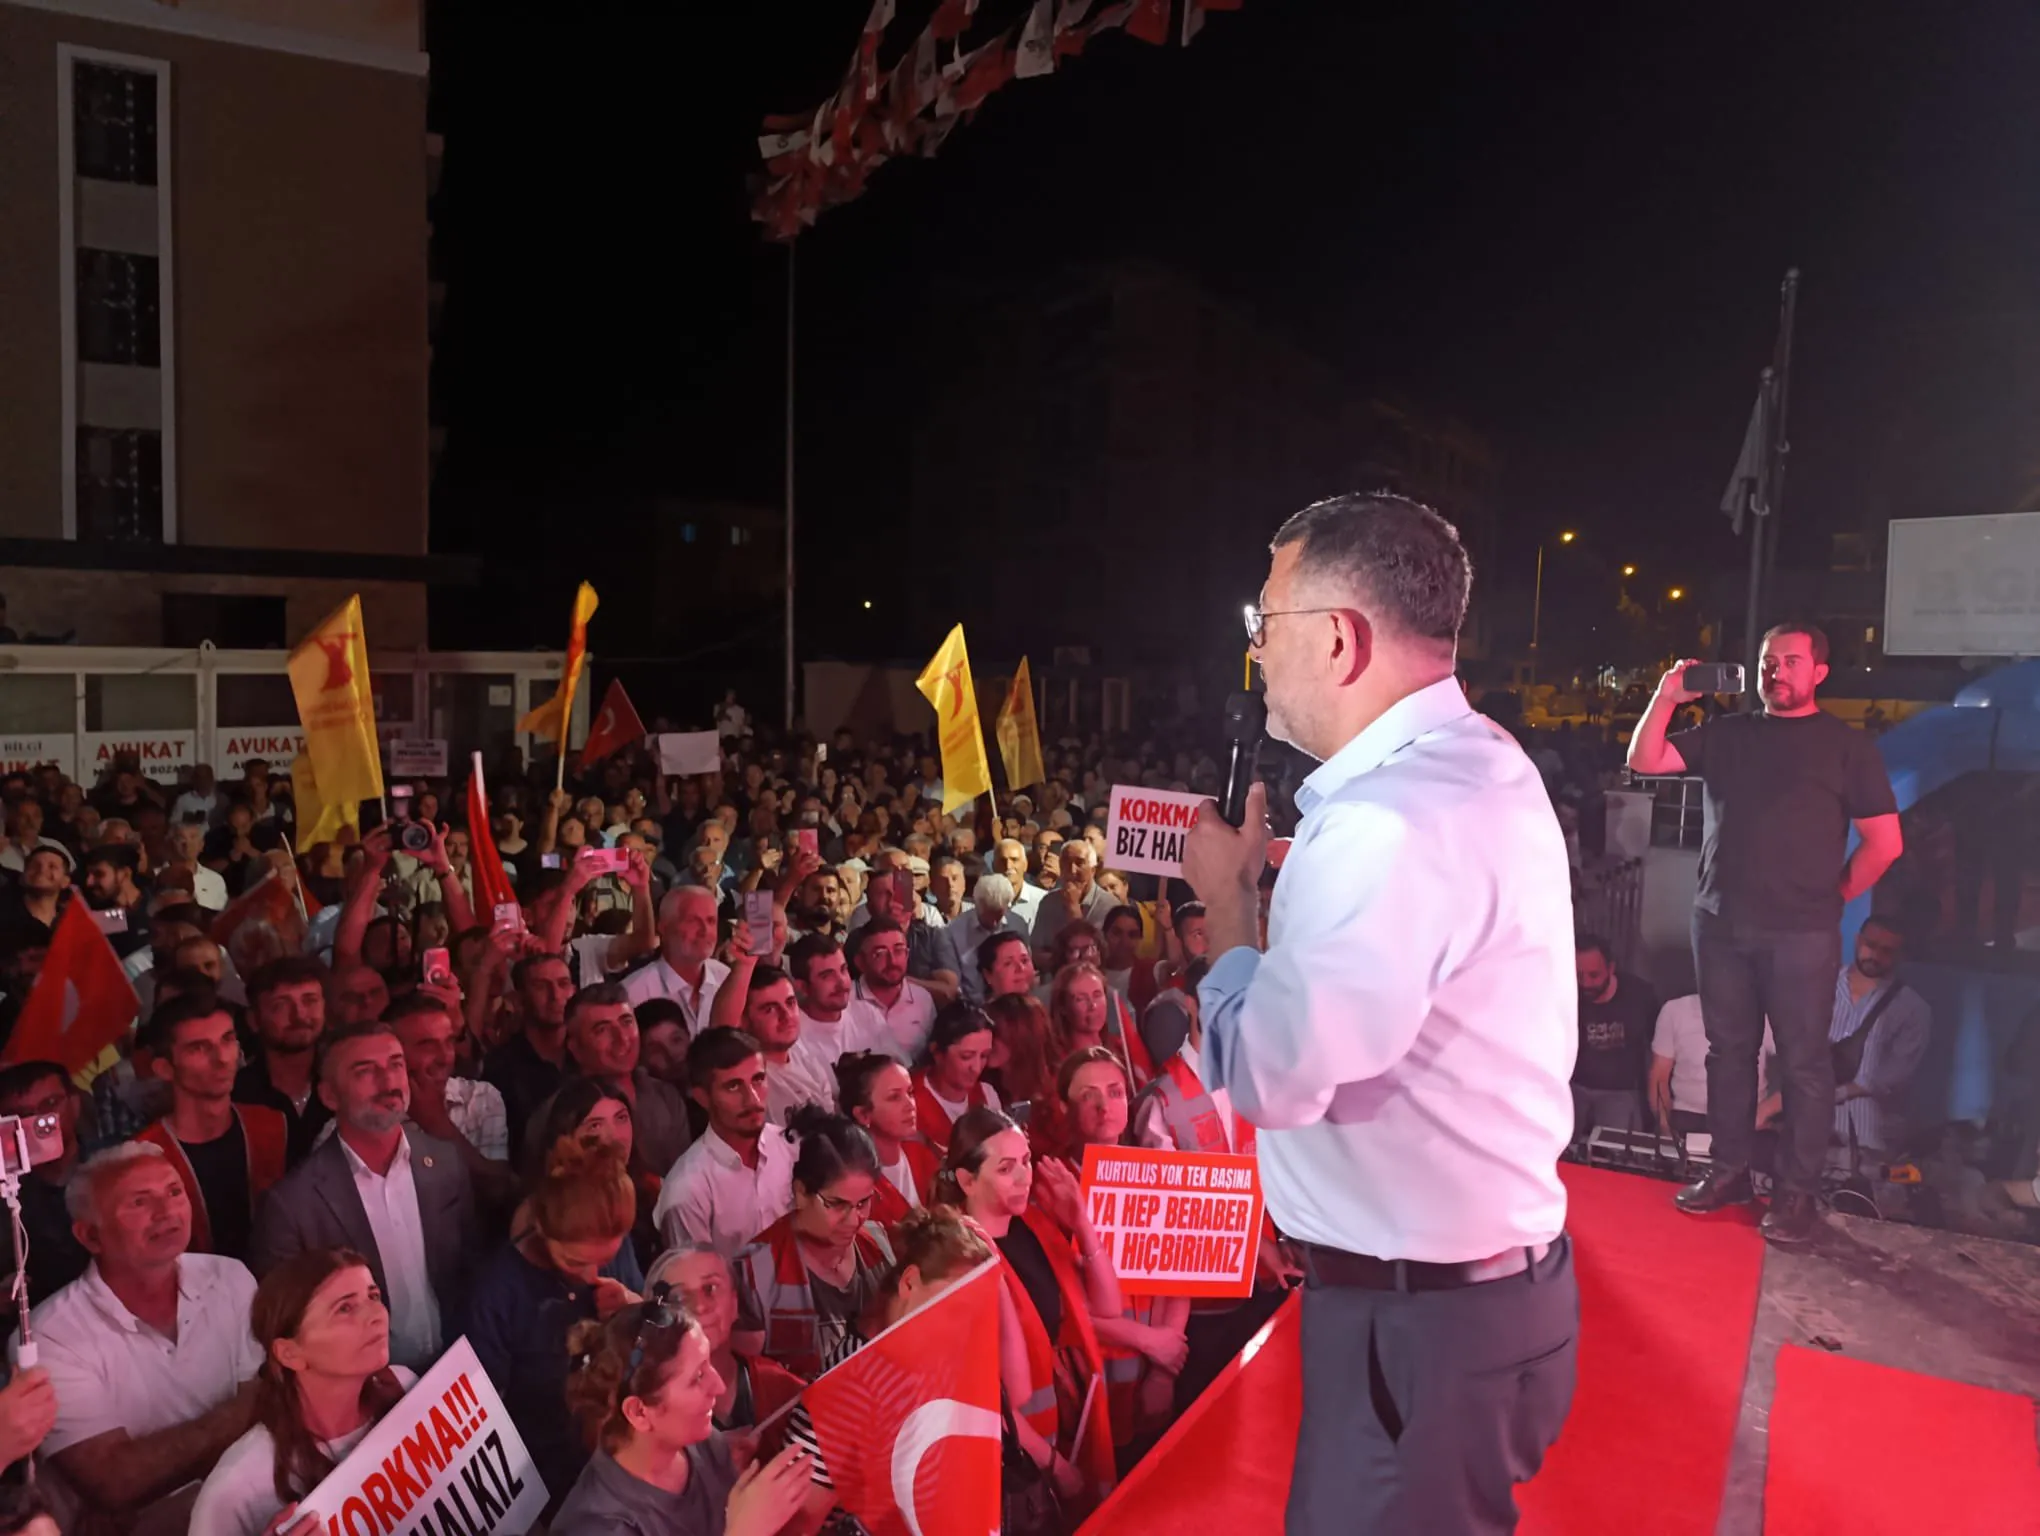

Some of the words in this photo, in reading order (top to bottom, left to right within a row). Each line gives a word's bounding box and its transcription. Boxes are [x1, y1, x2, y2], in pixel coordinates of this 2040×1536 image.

[227, 736, 304, 754] AVUKAT
[1096, 1160, 1158, 1187] KURTULUŞ
[1161, 1165, 1184, 1185] YOK
[1187, 1166, 1208, 1188] TEK
[1210, 1169, 1252, 1190] BAŞINA
[1092, 1191, 1117, 1226] YA
[1121, 1194, 1161, 1228] HEP
[1164, 1197, 1249, 1232] BERABER
[1120, 1232, 1245, 1275] HİÇBİRİMİZ
